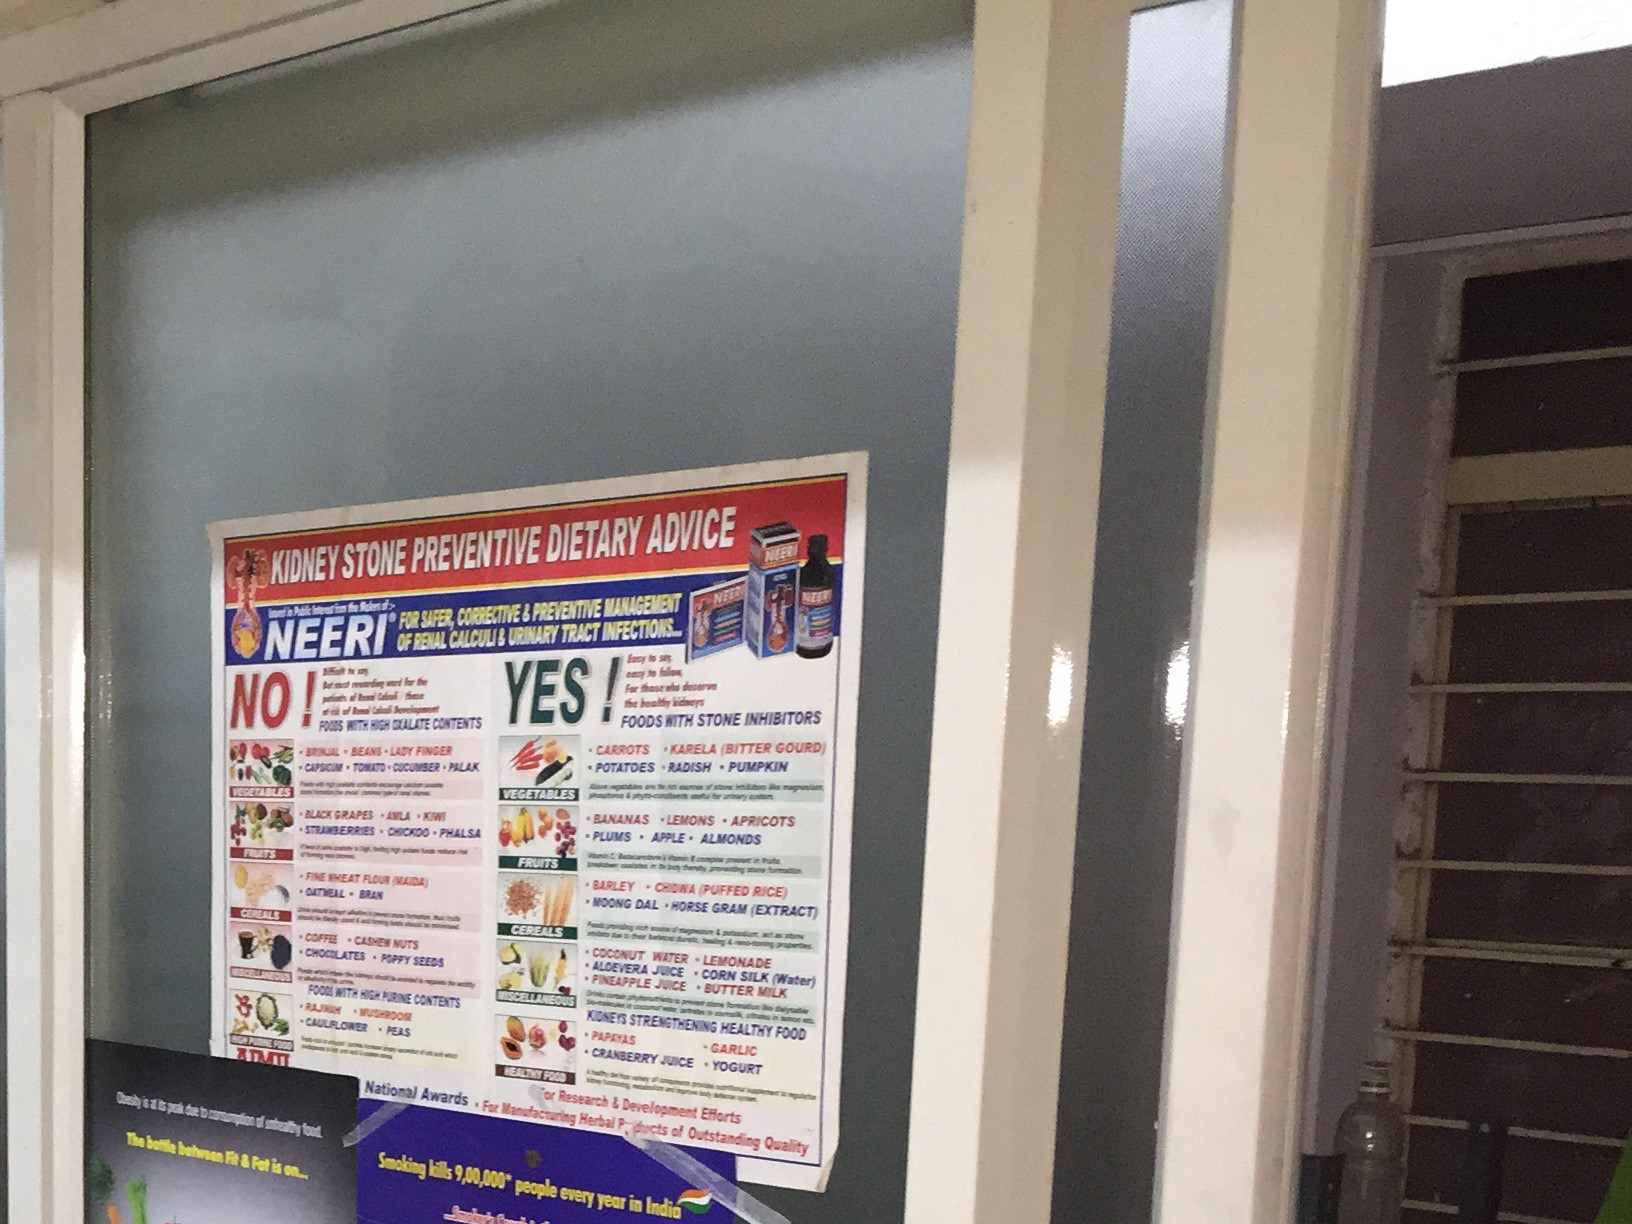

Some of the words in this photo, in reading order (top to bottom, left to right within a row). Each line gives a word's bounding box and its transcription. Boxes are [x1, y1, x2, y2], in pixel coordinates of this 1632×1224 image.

[270, 546, 338, 584] KIDNEY
[341, 538, 408, 579] STONE
[410, 525, 542, 573] PREVENTIVE
[545, 515, 644, 563] DIETARY
[646, 506, 737, 554] ADVICE
[457, 604, 522, 626] CORRECTIVE
[532, 599, 602, 621] PREVENTIVE
[603, 592, 683, 616] MANAGEMENT
[264, 612, 388, 661] NEERI
[449, 628, 497, 650] CALCULI
[508, 623, 560, 646] URINARY
[561, 621, 600, 644] TRACT
[504, 656, 590, 726] YES
[620, 713, 663, 729] FOODS
[665, 712, 694, 728] WITH
[696, 711, 741, 727] STONE
[744, 710, 823, 726] INHIBITORS
[596, 743, 650, 757] CARROTS
[669, 743, 717, 756] KARELA
[720, 742, 772, 757] (BITTER
[775, 742, 826, 756] GOURD)
[595, 761, 655, 774] POTATOES
[667, 761, 712, 774] RADISH
[728, 761, 789, 773] PUMPKIN
[502, 788, 576, 801] VEGETABLES
[592, 814, 649, 826] BANANAS
[666, 815, 715, 826] LEMONS
[730, 815, 795, 828] APRICOTS
[592, 831, 632, 843] PLUMS
[651, 832, 686, 844] APPLE
[700, 833, 762, 846] ALMONDS
[517, 858, 559, 870] FRUITS
[636, 899, 659, 910] DAL
[671, 900, 708, 912] HORSE
[712, 902, 747, 914] GRAM
[750, 904, 818, 919] (EXTRACT)
[510, 925, 564, 938] CEREALS
[592, 947, 646, 961] COCONUT
[652, 951, 689, 964] WATER
[703, 955, 772, 969] LEMONADE
[592, 962, 648, 975] ALOEVERA
[652, 965, 684, 977] JUICE
[702, 968, 735, 981] CORN
[739, 971, 768, 983] SILK
[772, 973, 816, 988] (Water)
[592, 974, 651, 988] PINEAPPLE
[654, 979, 686, 991] JUICE
[704, 983, 753, 995] BUTTER
[757, 986, 787, 998] MILK
[710, 1042, 758, 1056] GARLIC
[712, 1061, 763, 1075] YOGURT
[365, 1081, 418, 1100] National
[421, 1087, 468, 1106] Awards
[559, 1089, 609, 1108] Research
[613, 1096, 619, 1108] &
[623, 1098, 698, 1121] Development
[700, 1108, 741, 1125] Efforts
[378, 1152, 426, 1177] Smoking
[429, 1158, 453, 1179] kills
[515, 1178, 557, 1201] people
[561, 1186, 594, 1204] every
[597, 1191, 626, 1211] year
[629, 1195, 642, 1213] in
[646, 1197, 682, 1219] India
